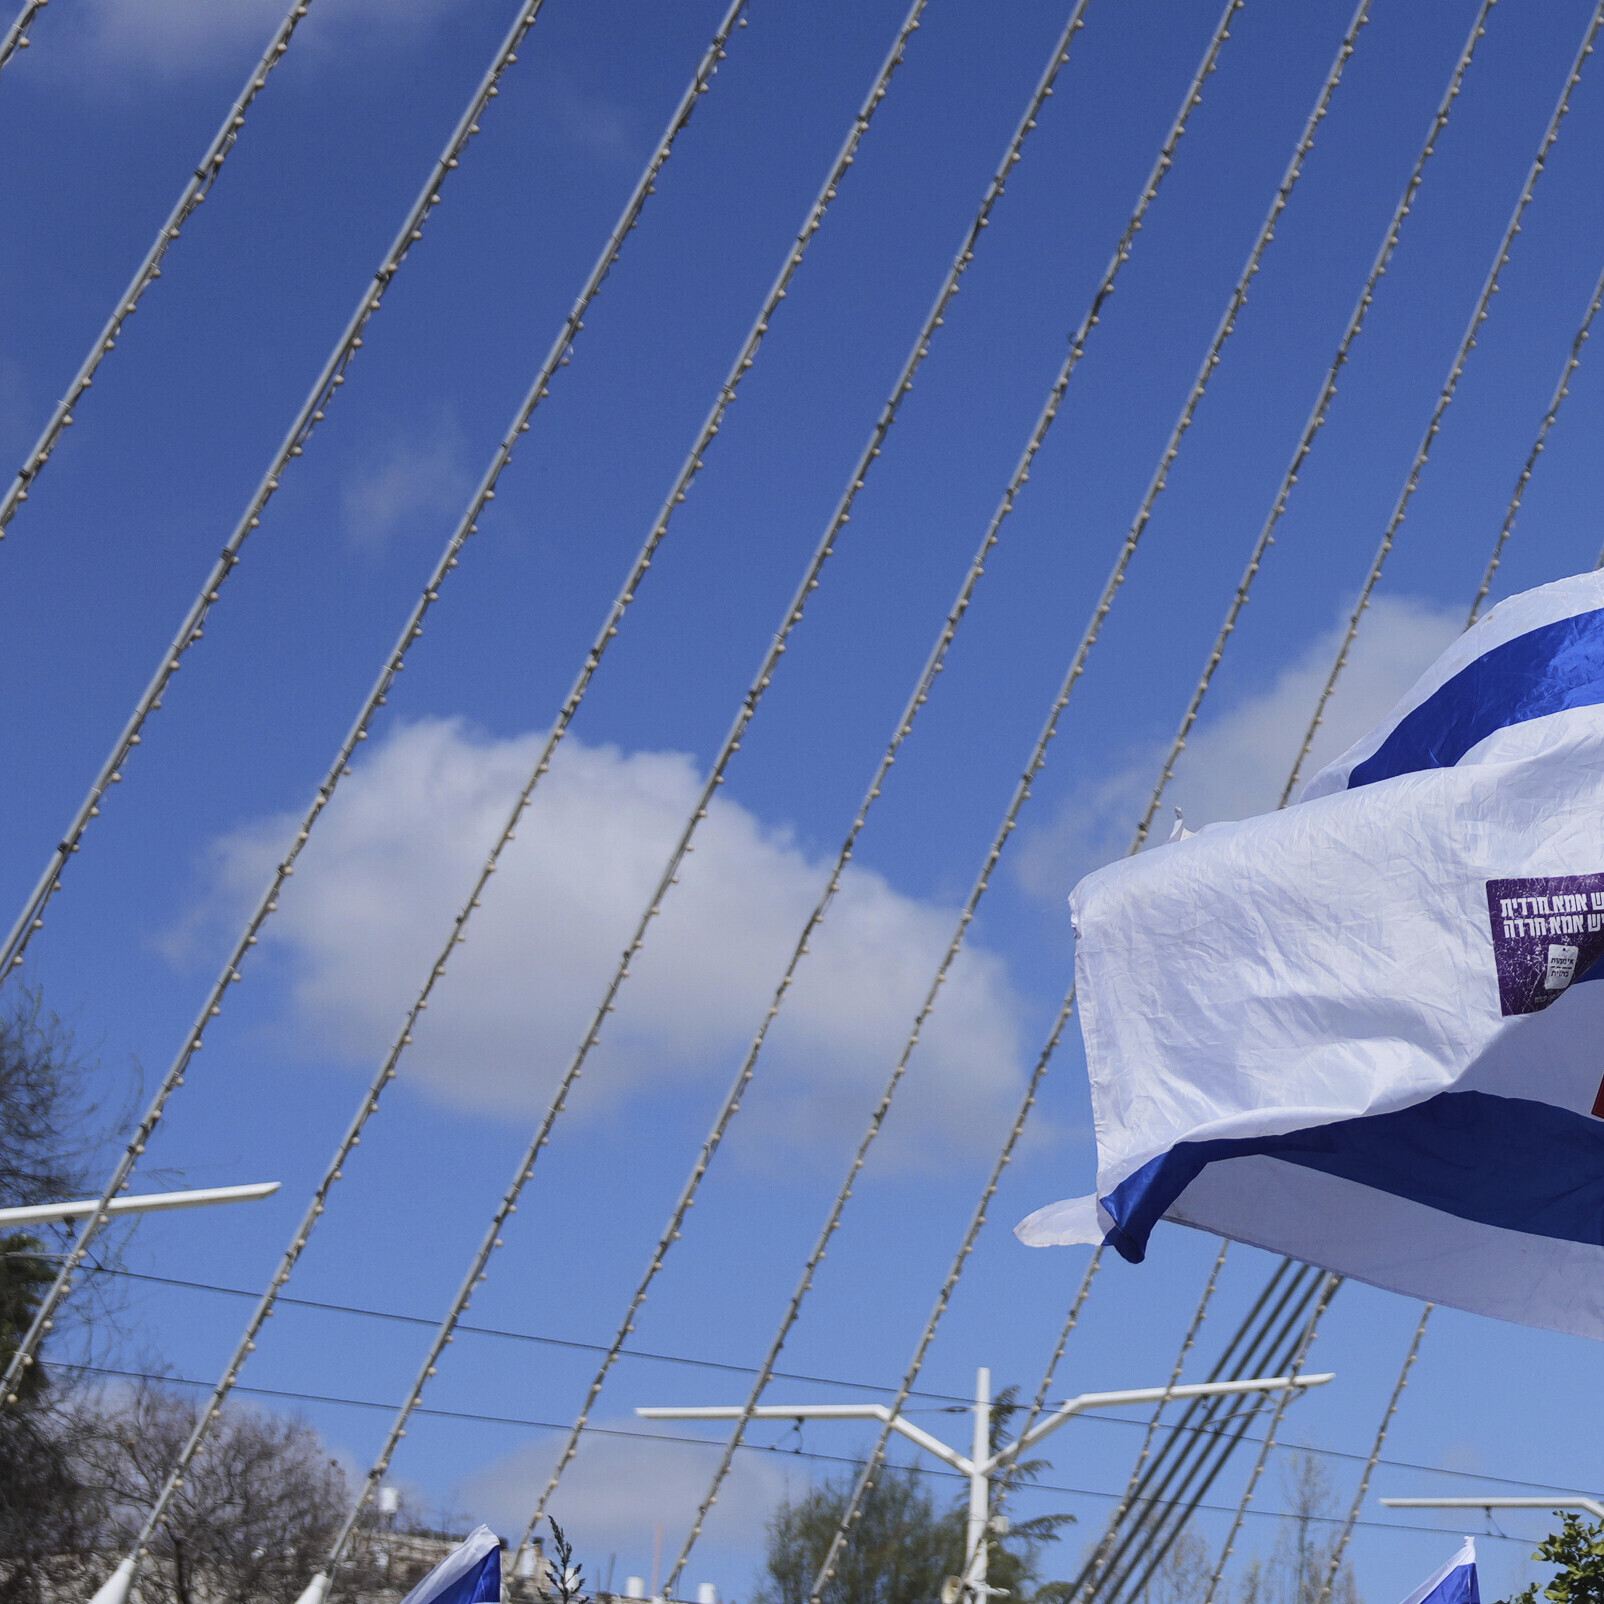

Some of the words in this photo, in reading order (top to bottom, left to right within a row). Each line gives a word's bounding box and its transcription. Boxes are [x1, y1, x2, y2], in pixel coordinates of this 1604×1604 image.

[1500, 896, 1550, 917] חרדית
[1552, 893, 1588, 914] אמא
[1503, 917, 1547, 938] חרדה
[1549, 914, 1584, 935] אמא
